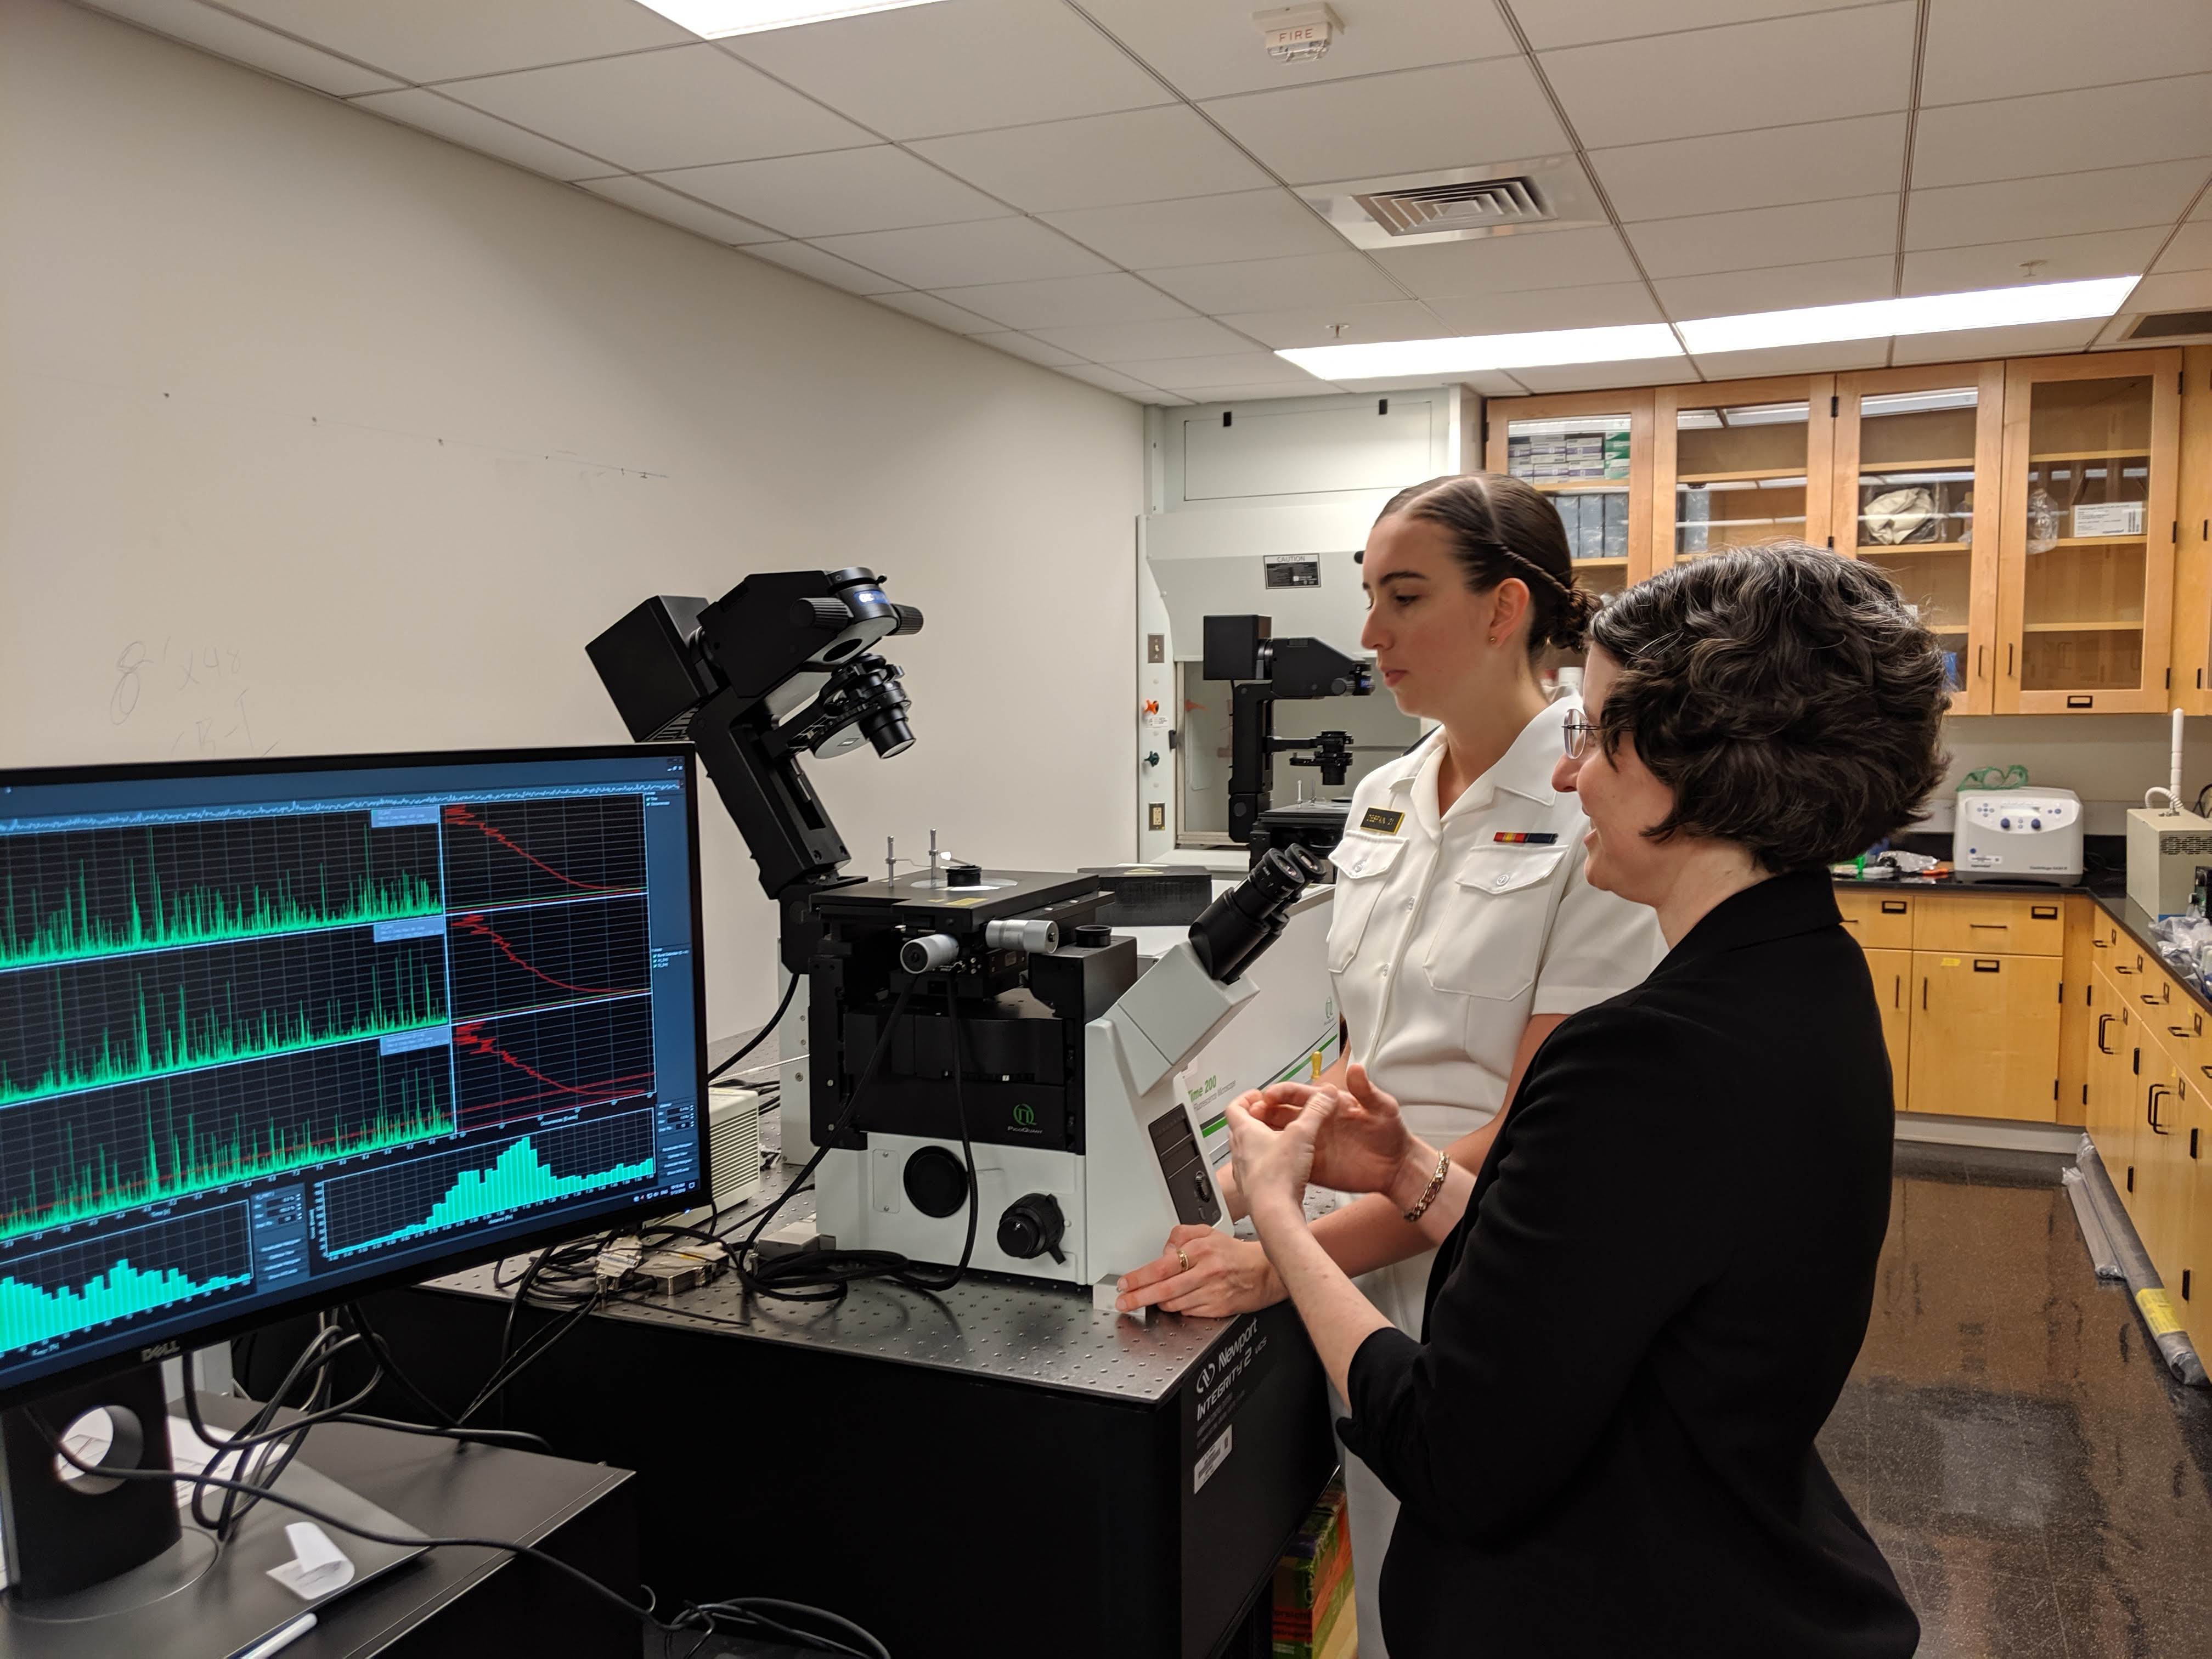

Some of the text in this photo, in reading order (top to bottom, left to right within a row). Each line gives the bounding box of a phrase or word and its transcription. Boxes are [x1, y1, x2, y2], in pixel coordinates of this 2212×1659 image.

[1279, 28, 1313, 43] FIRE
[1204, 1075, 1216, 1094] 200
[141, 1340, 180, 1363] DELL
[1218, 1317, 1258, 1372] Newport
[1197, 1360, 1243, 1421] INTEGRITY
[1244, 1347, 1252, 1368] 2
